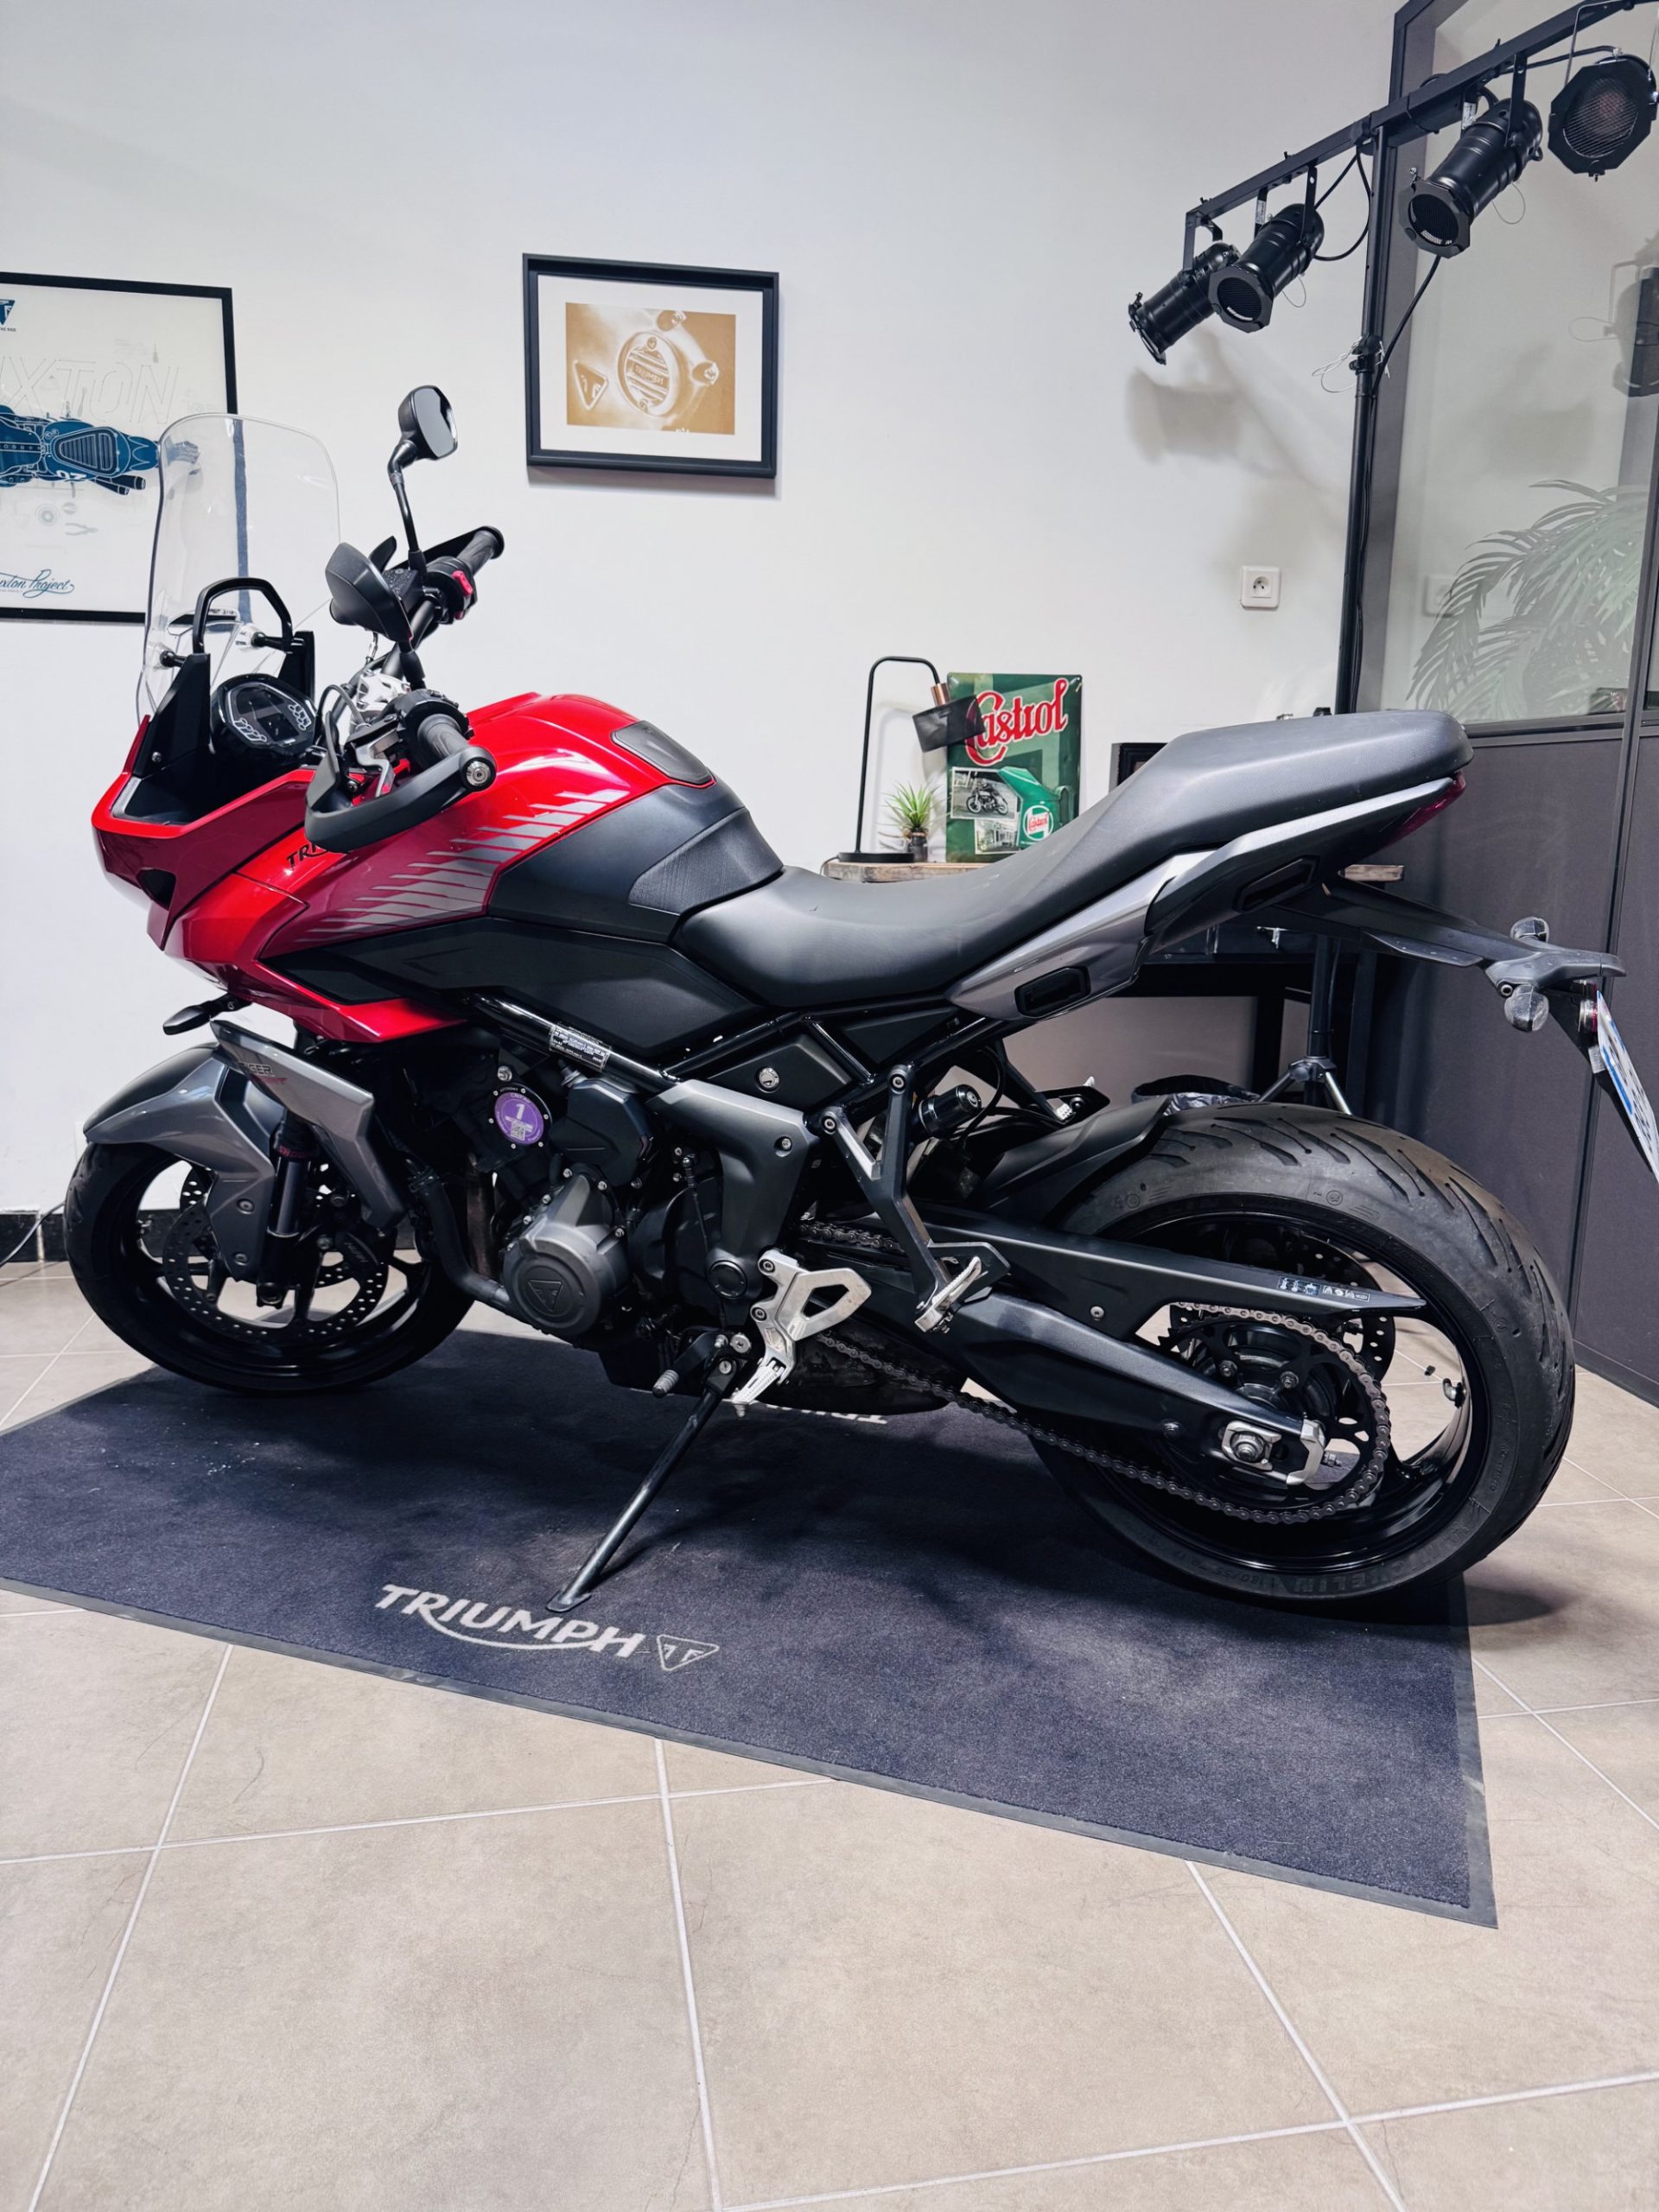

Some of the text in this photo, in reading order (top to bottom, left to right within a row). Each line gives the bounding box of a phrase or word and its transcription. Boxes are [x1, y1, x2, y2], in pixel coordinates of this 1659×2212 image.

[0, 356, 180, 424] XTON
[22, 569, 75, 598] Project
[965, 677, 1069, 766] Castrol
[374, 1583, 646, 1659] TRIUMPH
